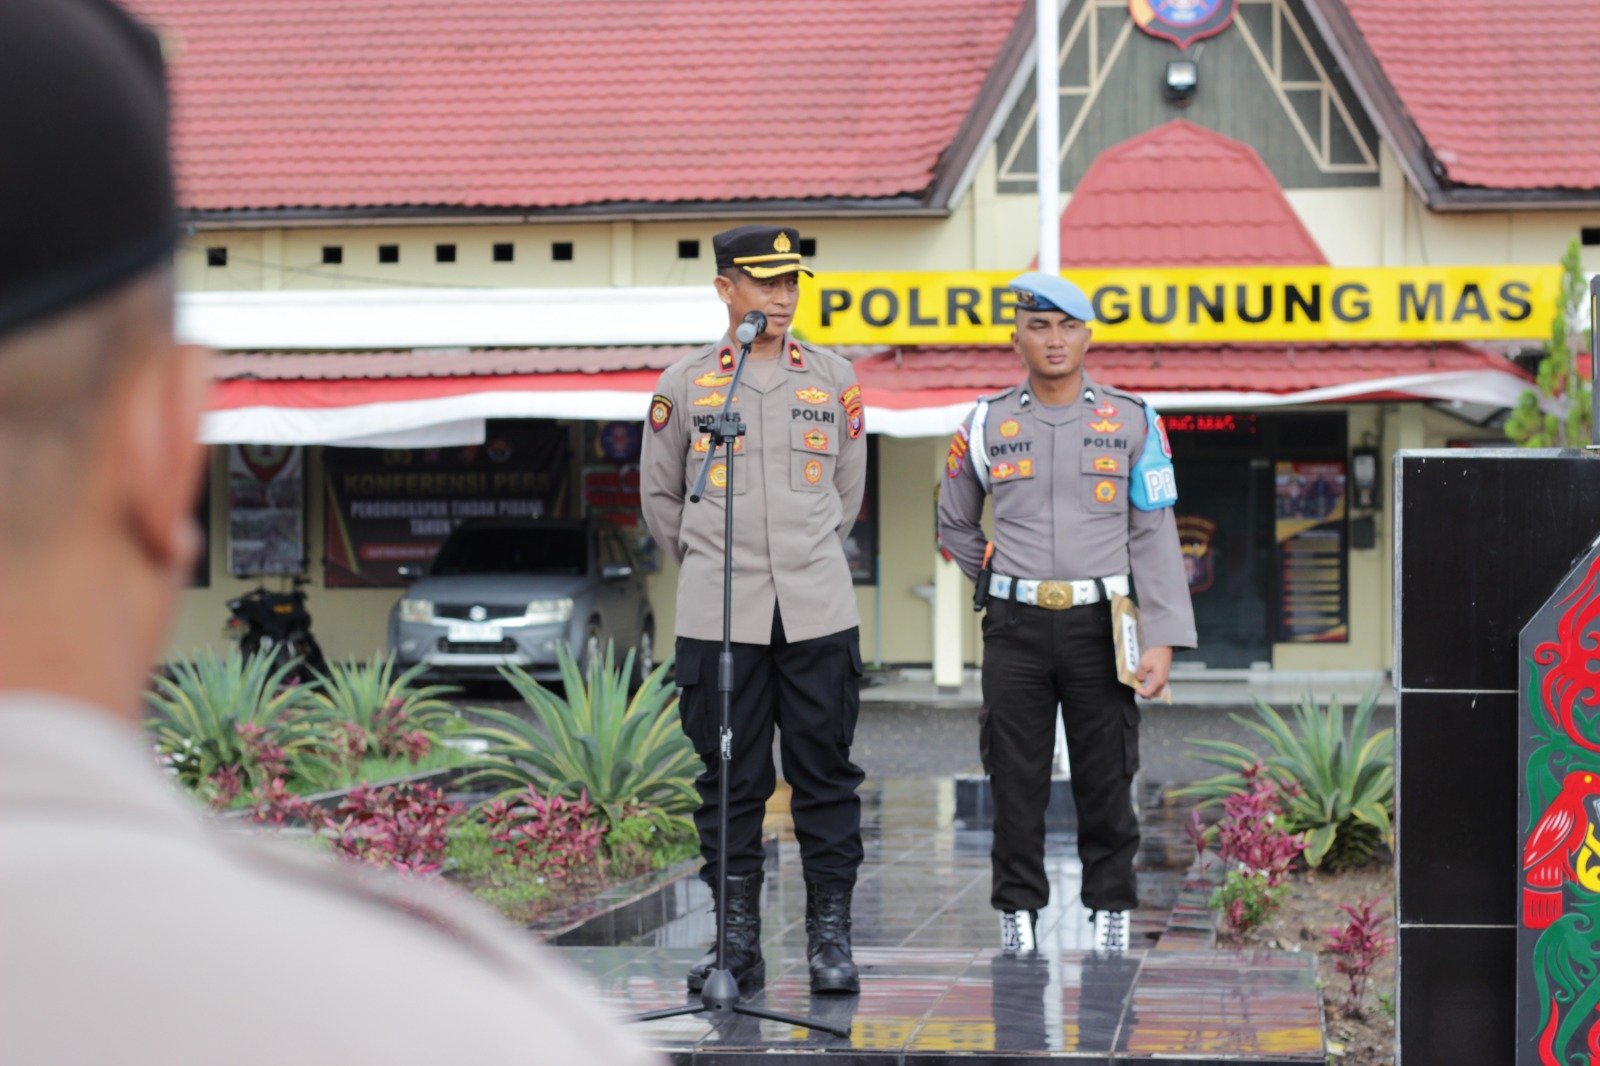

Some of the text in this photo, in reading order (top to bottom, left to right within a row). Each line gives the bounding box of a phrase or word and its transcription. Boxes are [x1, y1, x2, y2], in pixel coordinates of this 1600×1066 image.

[820, 281, 1533, 329] POLRE GUNUNG MAS
[791, 407, 835, 424] POLRI
[990, 440, 1033, 458] DEVIT
[1083, 436, 1128, 450] POLRI
